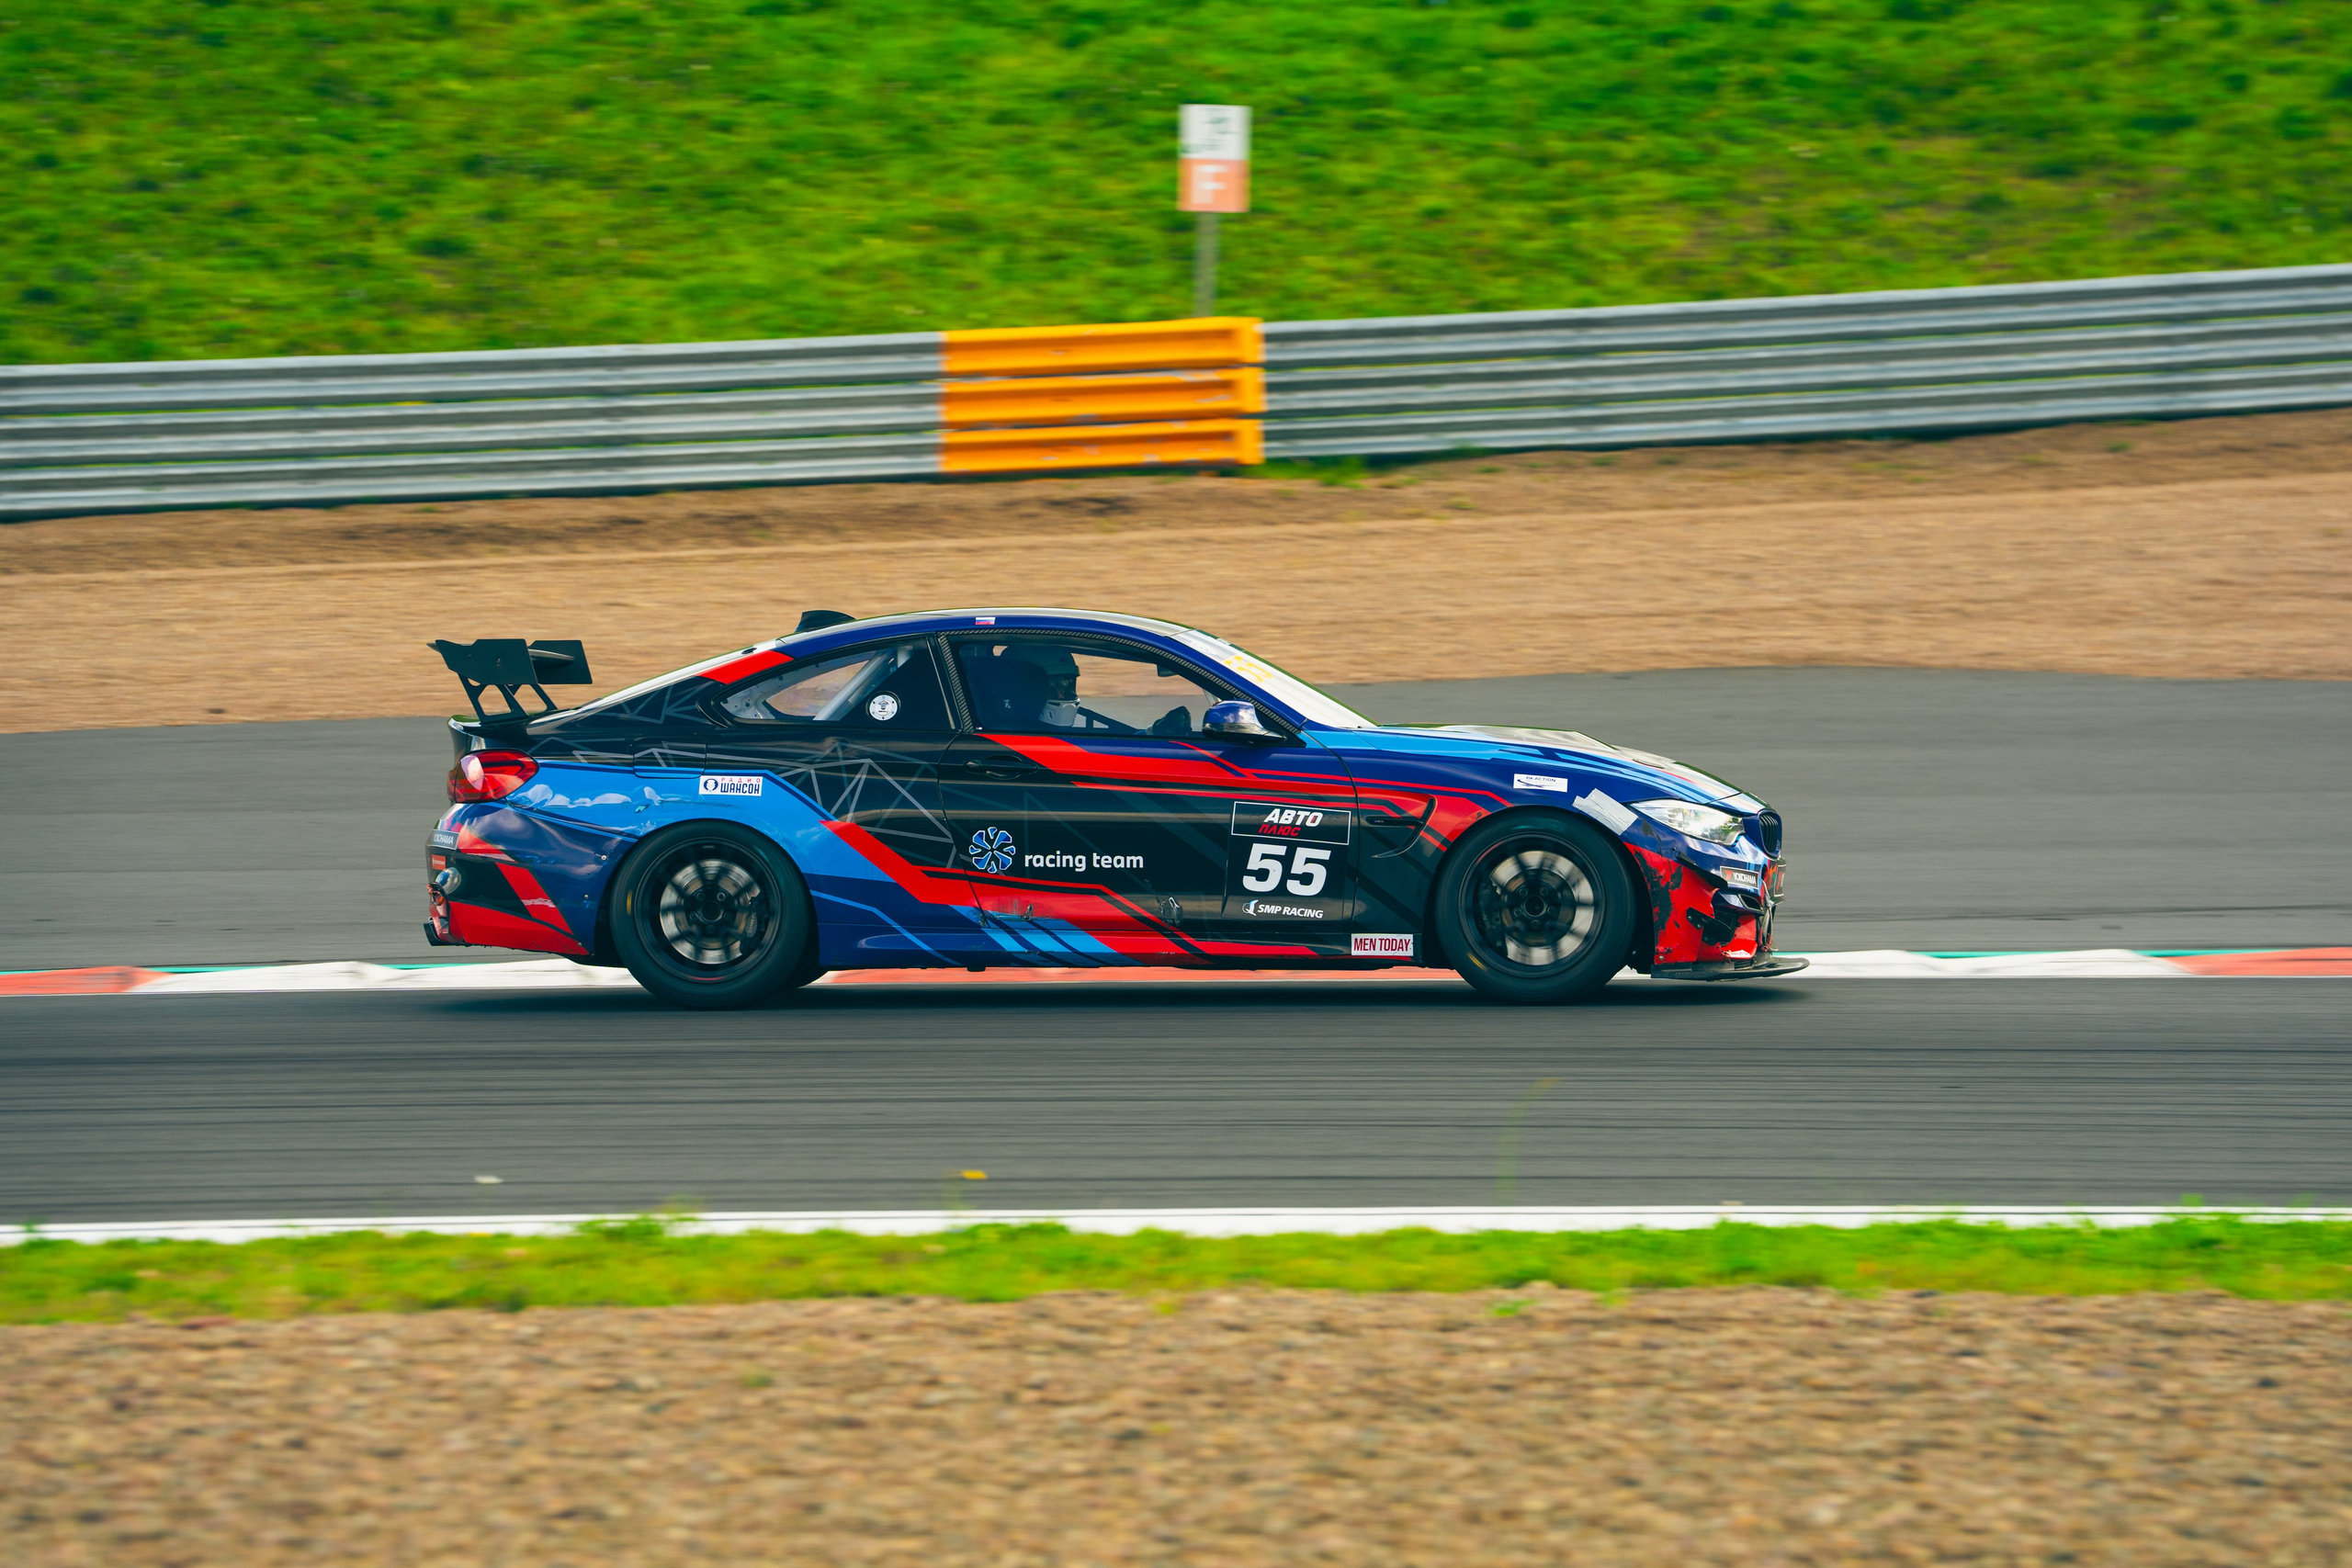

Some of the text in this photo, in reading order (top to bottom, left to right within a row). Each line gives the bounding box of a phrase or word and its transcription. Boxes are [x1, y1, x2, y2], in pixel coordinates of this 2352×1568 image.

[1191, 164, 1228, 204] F
[720, 783, 760, 795] ШАНСОН
[1263, 807, 1323, 828] АВТО
[1258, 824, 1302, 837] ПЛЮС
[1024, 850, 1144, 873] racing team
[1242, 842, 1331, 897] 55
[1257, 904, 1324, 919] SMP RACING
[1353, 938, 1411, 952] MEN TODAY
